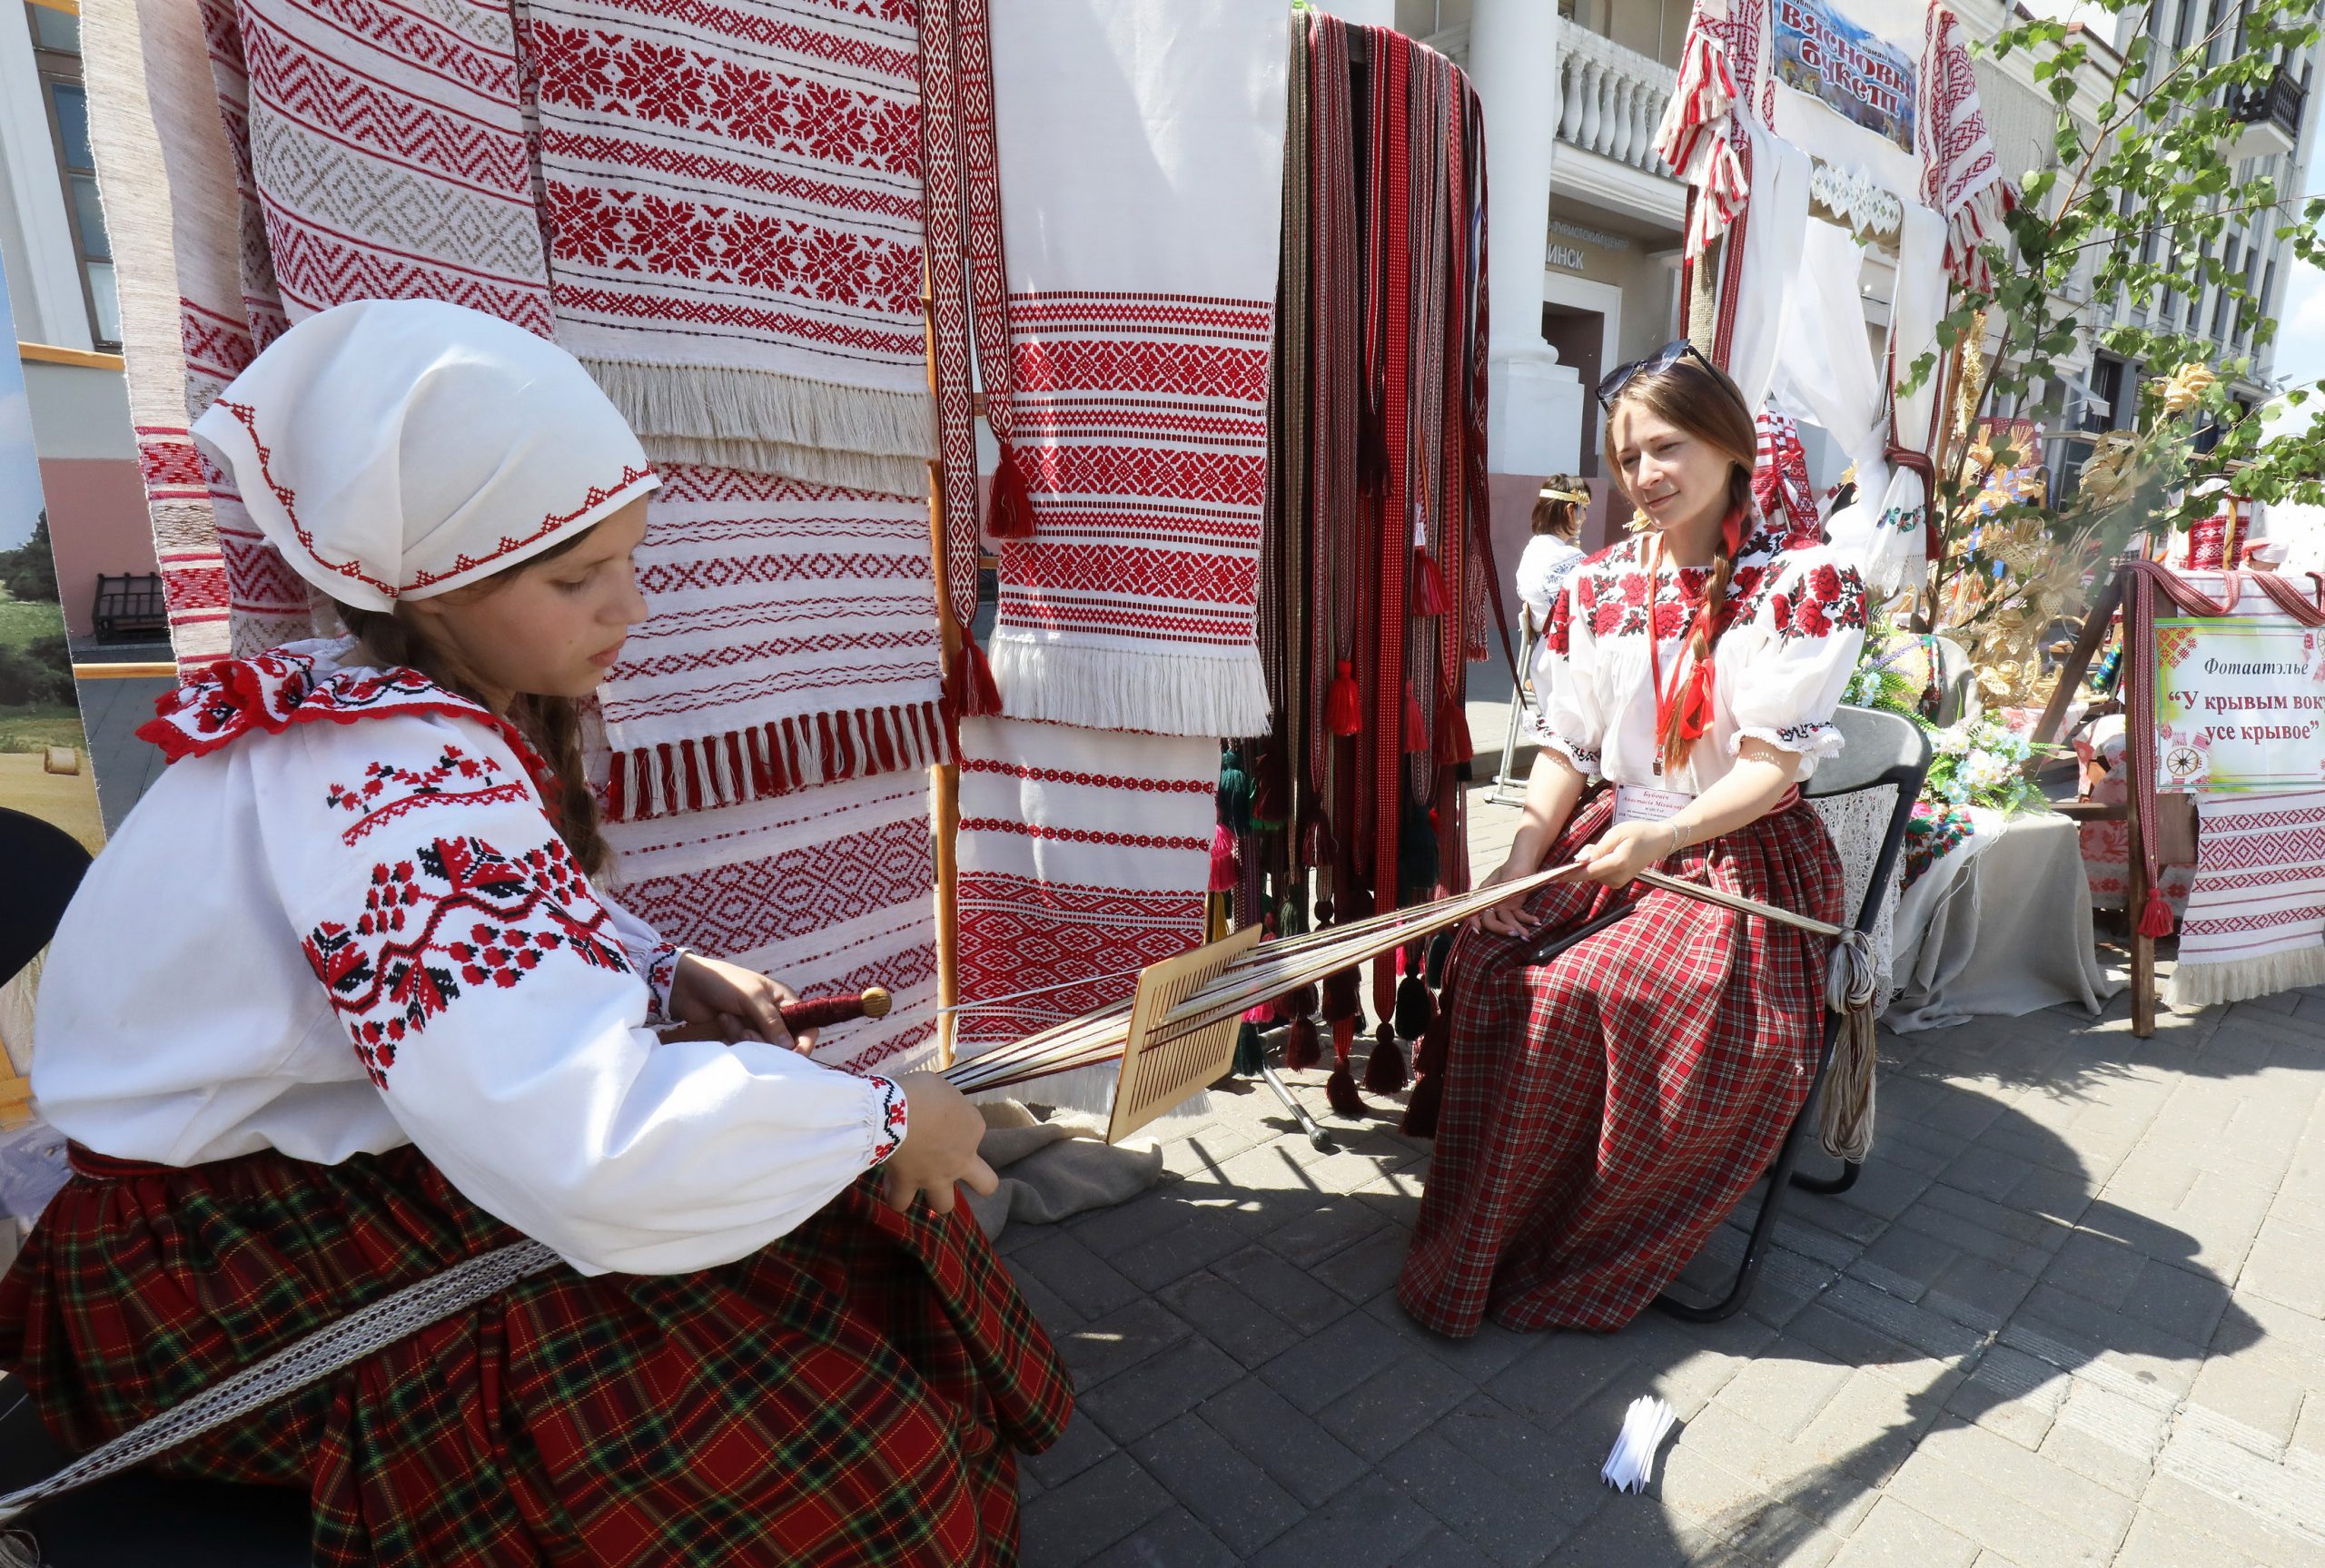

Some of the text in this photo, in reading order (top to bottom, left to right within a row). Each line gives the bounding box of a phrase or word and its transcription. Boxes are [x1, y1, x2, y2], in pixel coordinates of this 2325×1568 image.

[1547, 242, 1584, 270] ИНСК
[2204, 657, 2309, 675] Фотаатэлье
[2204, 695, 2288, 715] крывым
[2292, 695, 2325, 715] вок
[2204, 720, 2320, 745] усе крывое”
